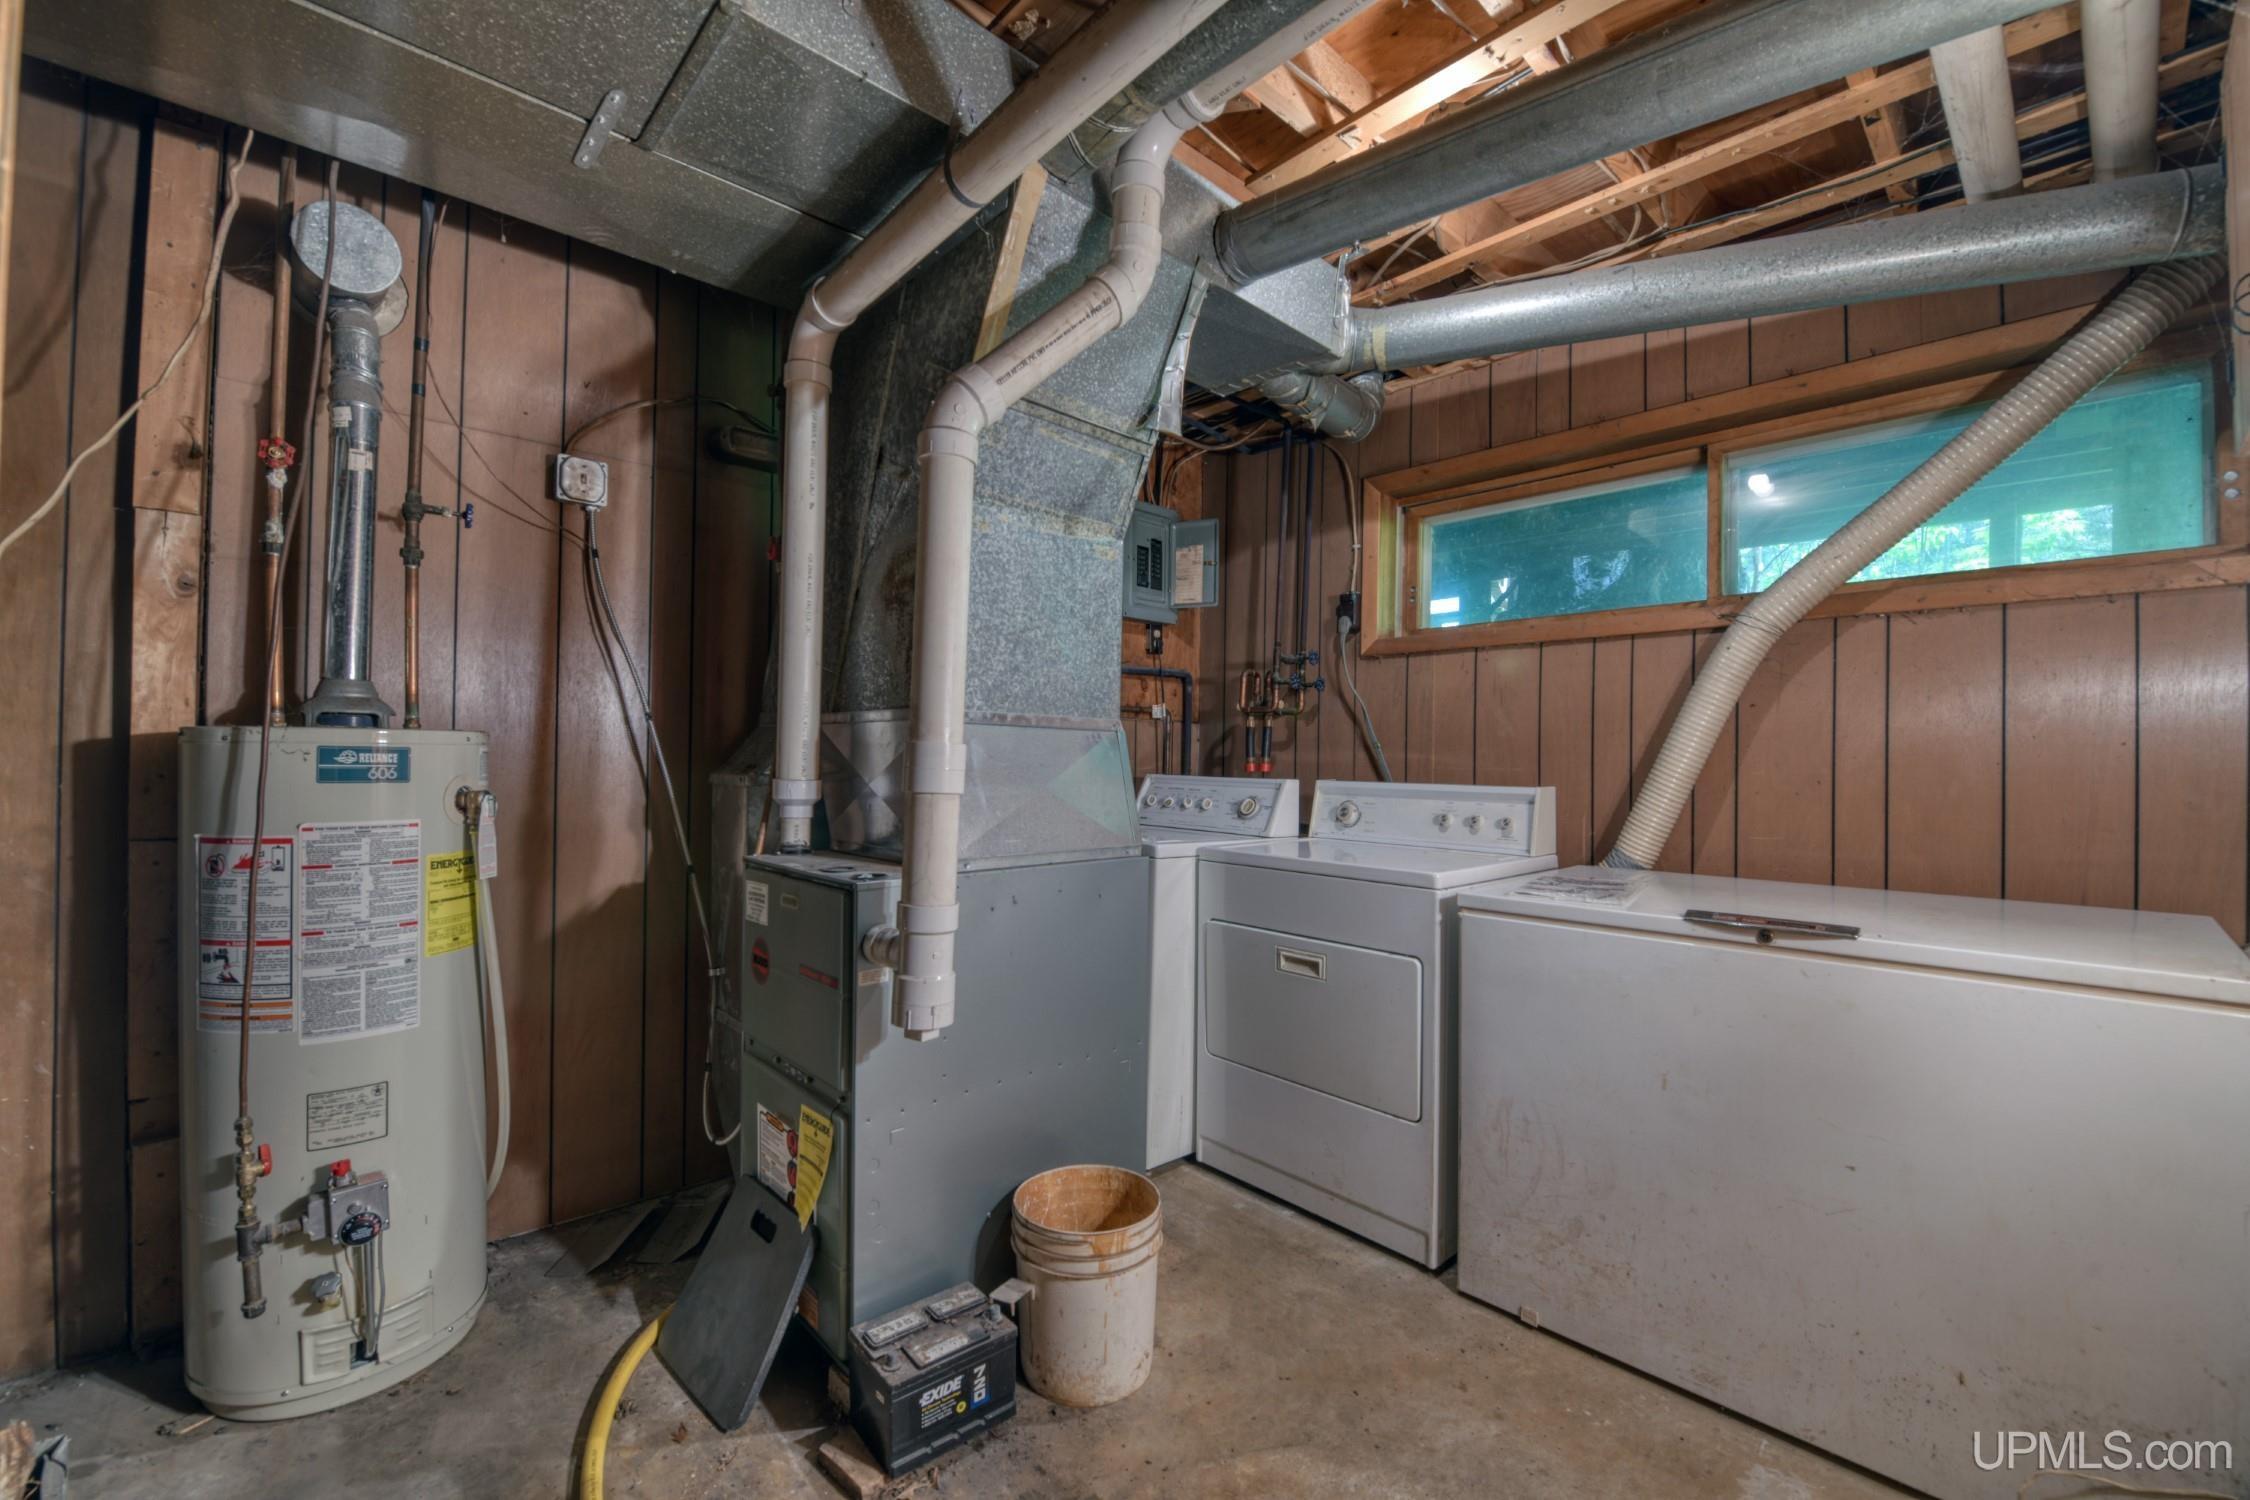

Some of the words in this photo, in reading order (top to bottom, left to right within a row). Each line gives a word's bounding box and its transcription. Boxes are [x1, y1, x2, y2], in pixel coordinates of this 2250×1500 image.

[358, 752, 399, 764] RELIANCE
[367, 766, 398, 780] 606
[919, 1374, 965, 1408] EXIDE
